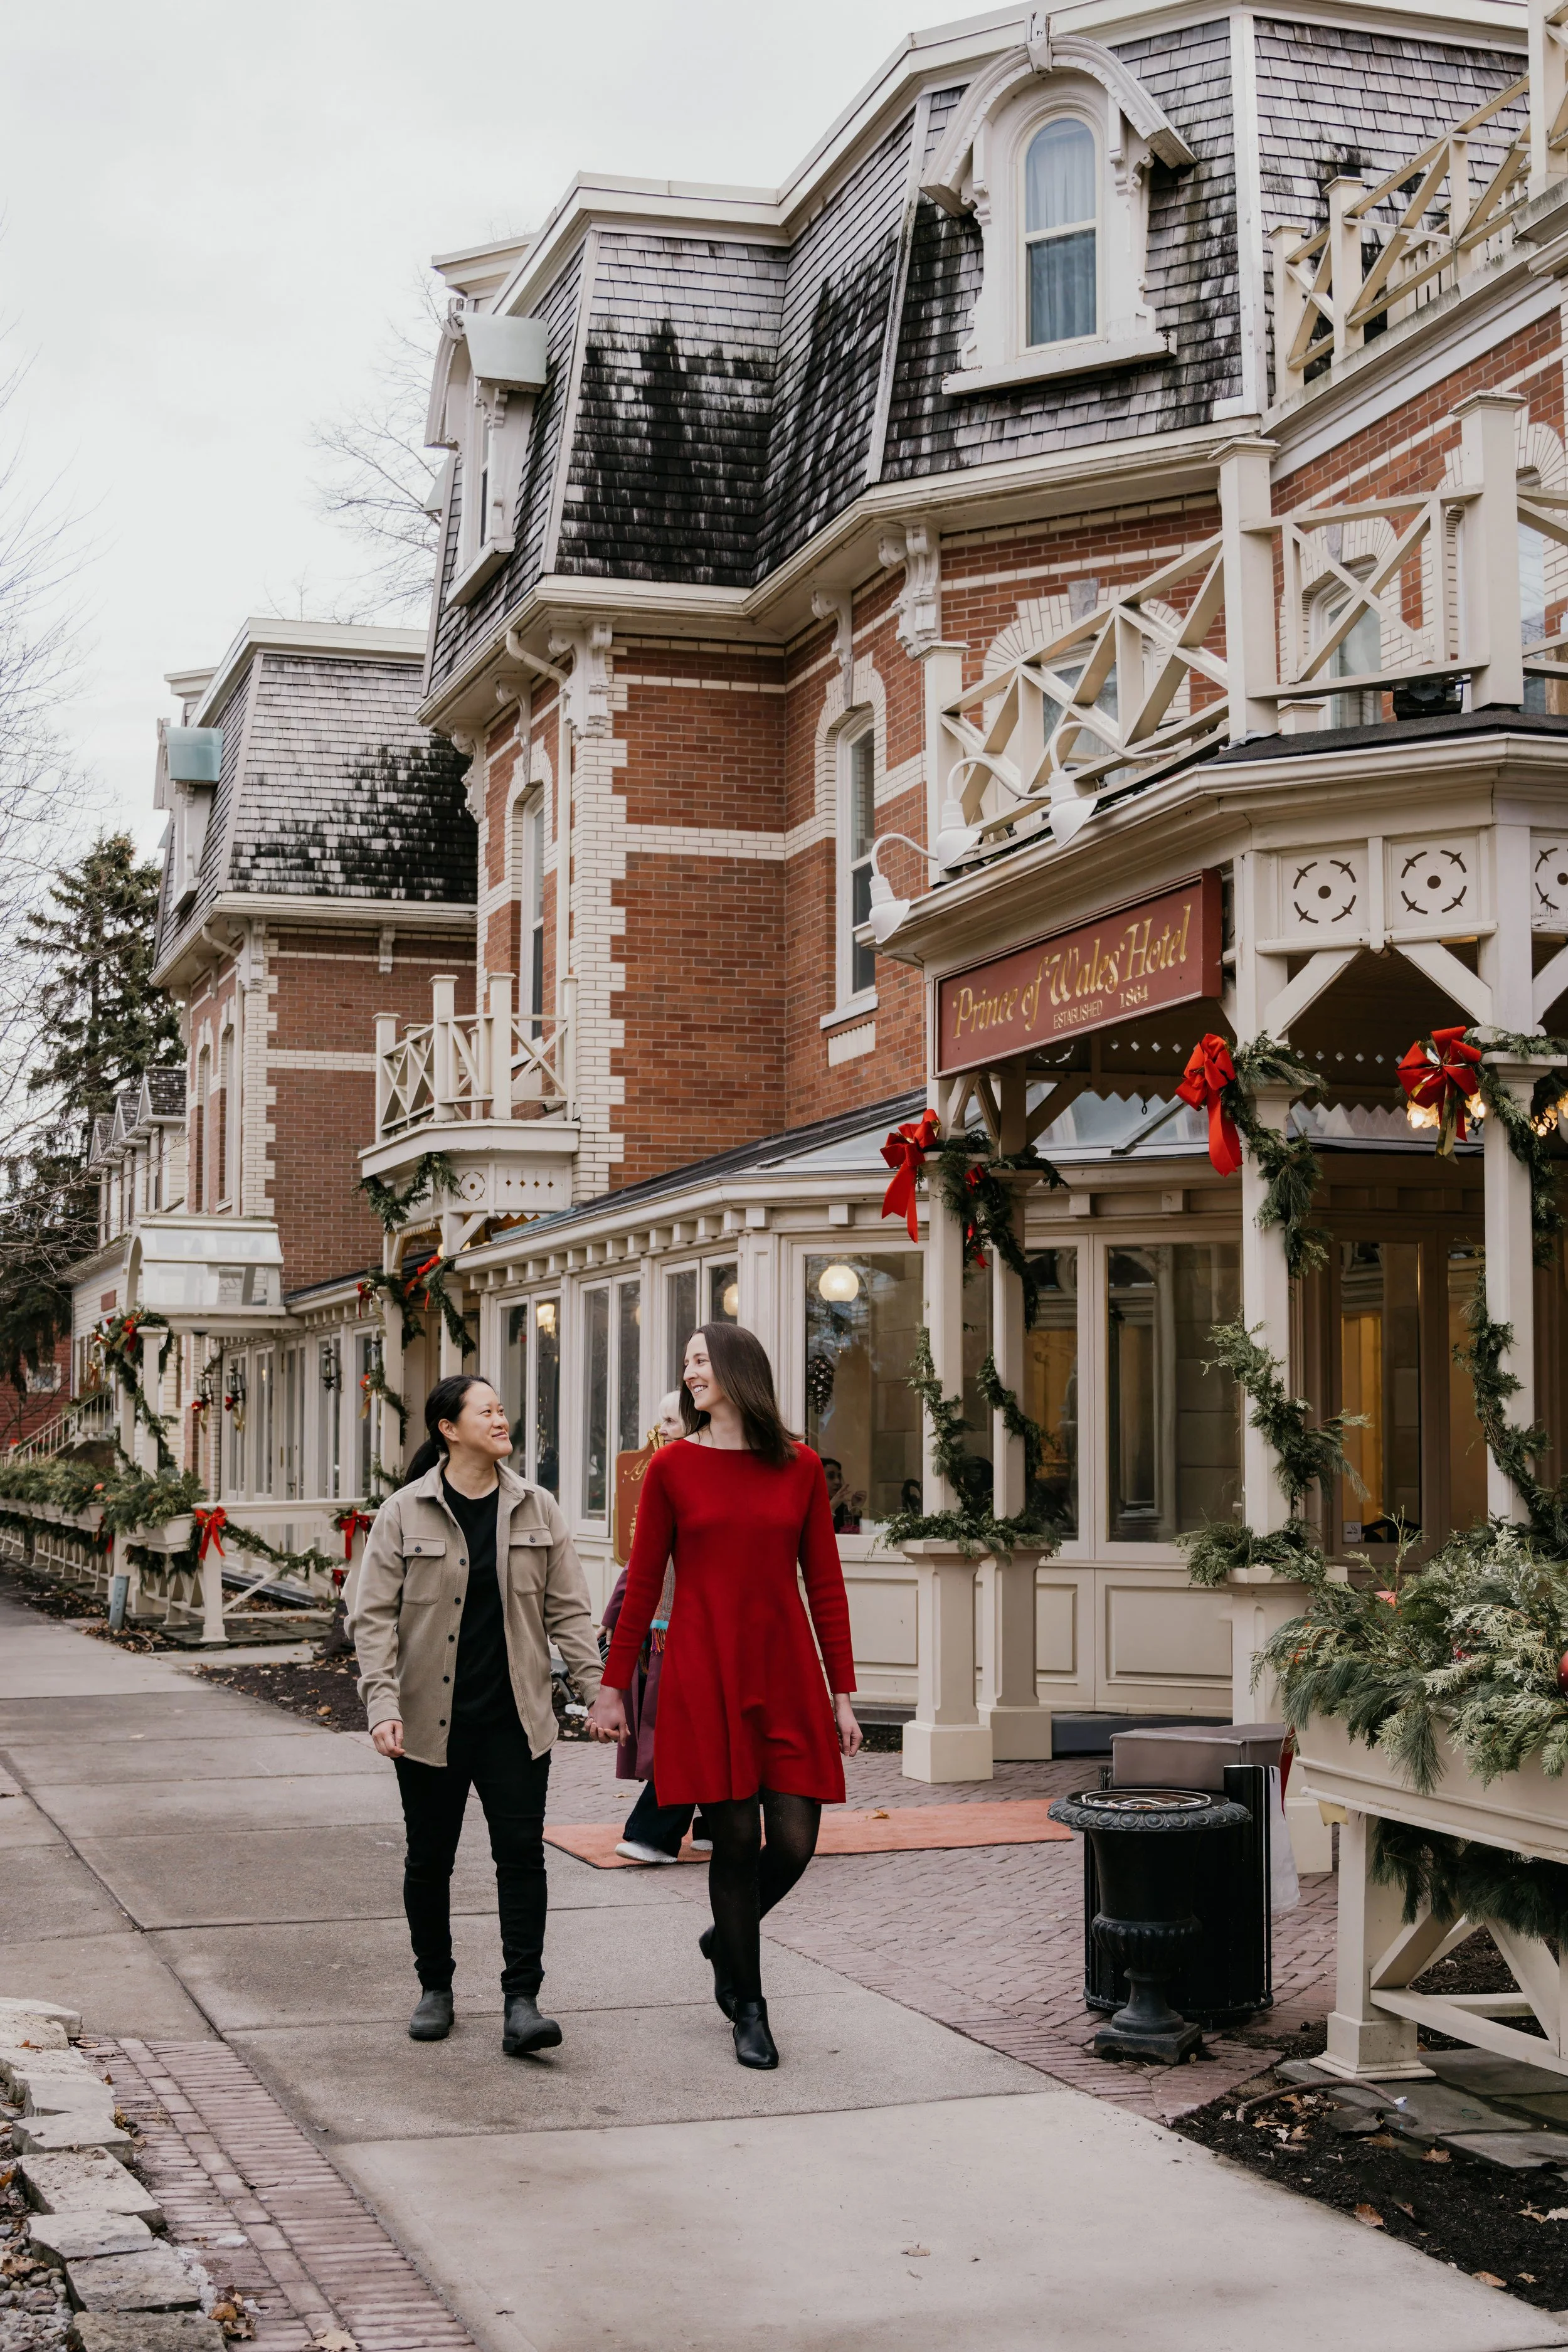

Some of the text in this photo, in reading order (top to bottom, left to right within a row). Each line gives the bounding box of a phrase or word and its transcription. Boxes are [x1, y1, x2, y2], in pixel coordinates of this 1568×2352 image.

[953, 904, 1191, 1039] Prince of Wales Hotel
[1053, 983, 1149, 1029] ESTABLISHED 1864
